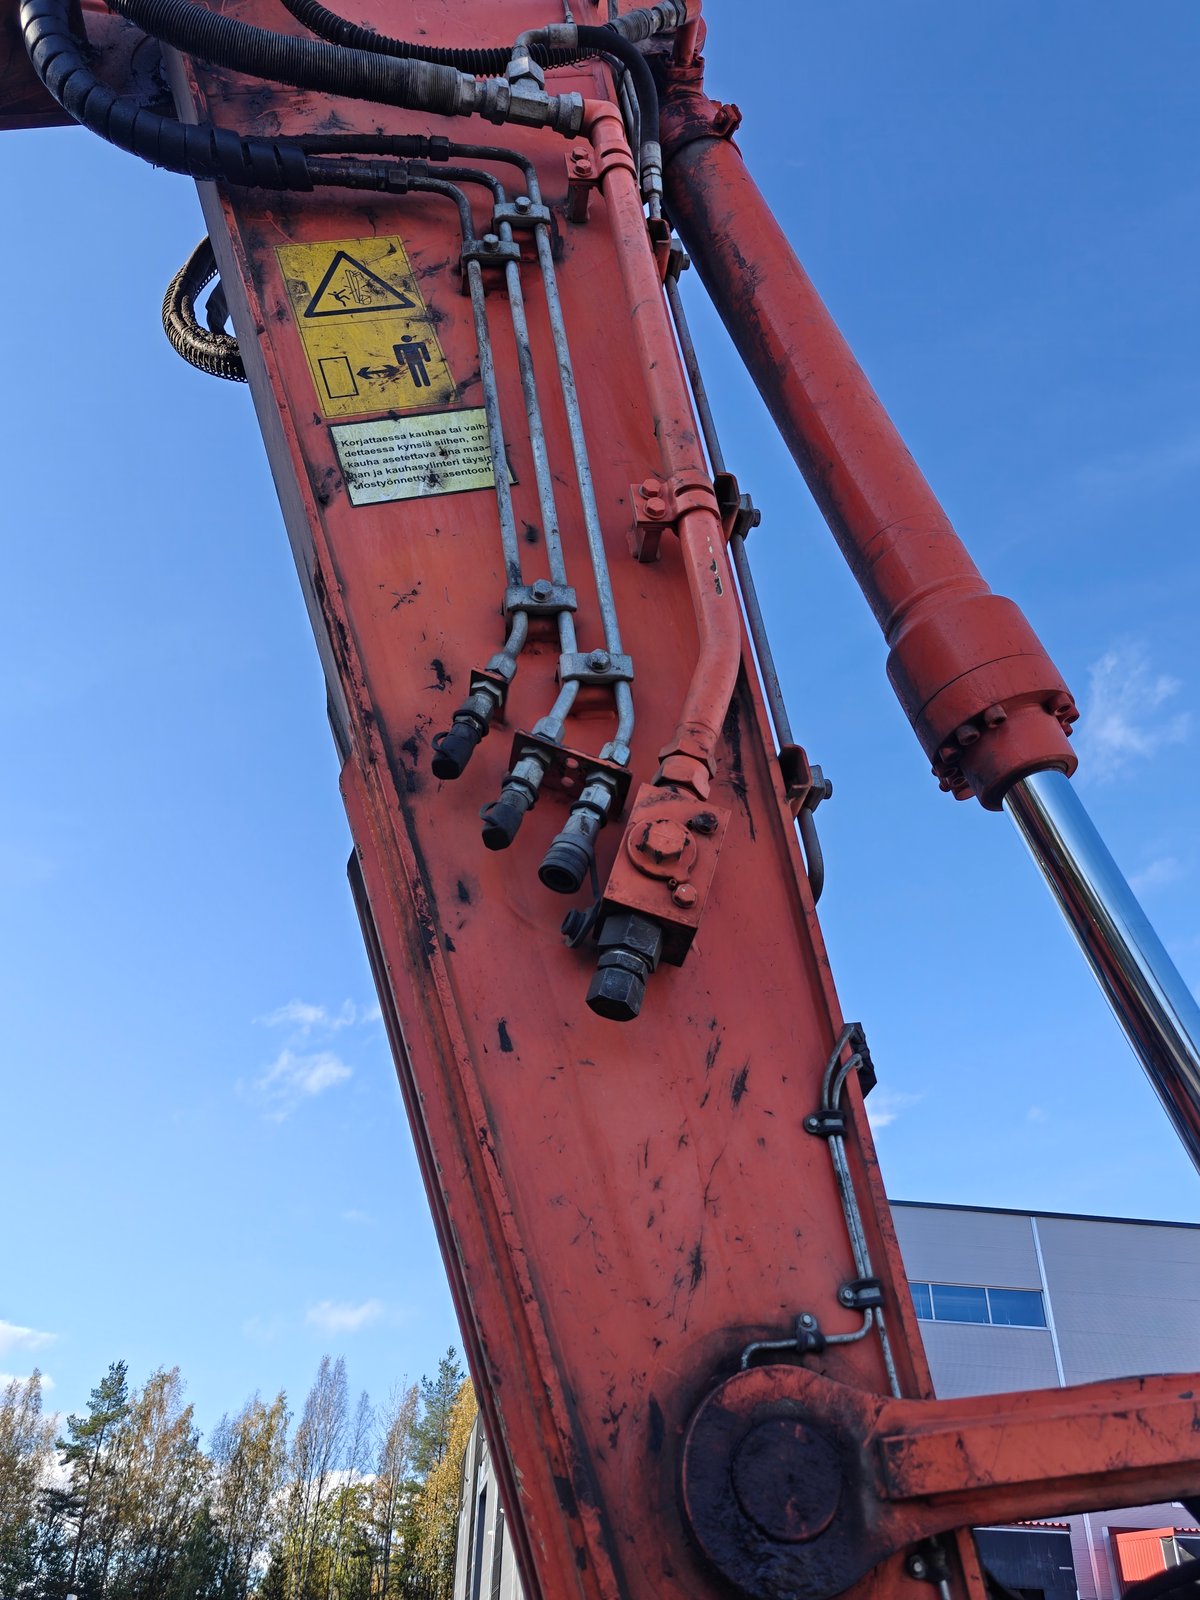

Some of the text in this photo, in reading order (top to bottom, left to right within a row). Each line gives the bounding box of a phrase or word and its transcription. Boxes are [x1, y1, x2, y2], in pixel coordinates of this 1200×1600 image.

[341, 434, 406, 447] Korjattaessa
[409, 429, 446, 438] kauhaa
[344, 446, 394, 458] dettaessa
[397, 440, 432, 452] kynsiä
[434, 438, 469, 446] siihen,
[347, 460, 380, 468] kauha
[382, 452, 436, 464] asetettava
[373, 469, 383, 478] ja
[386, 460, 460, 474] kauhasylinteri
